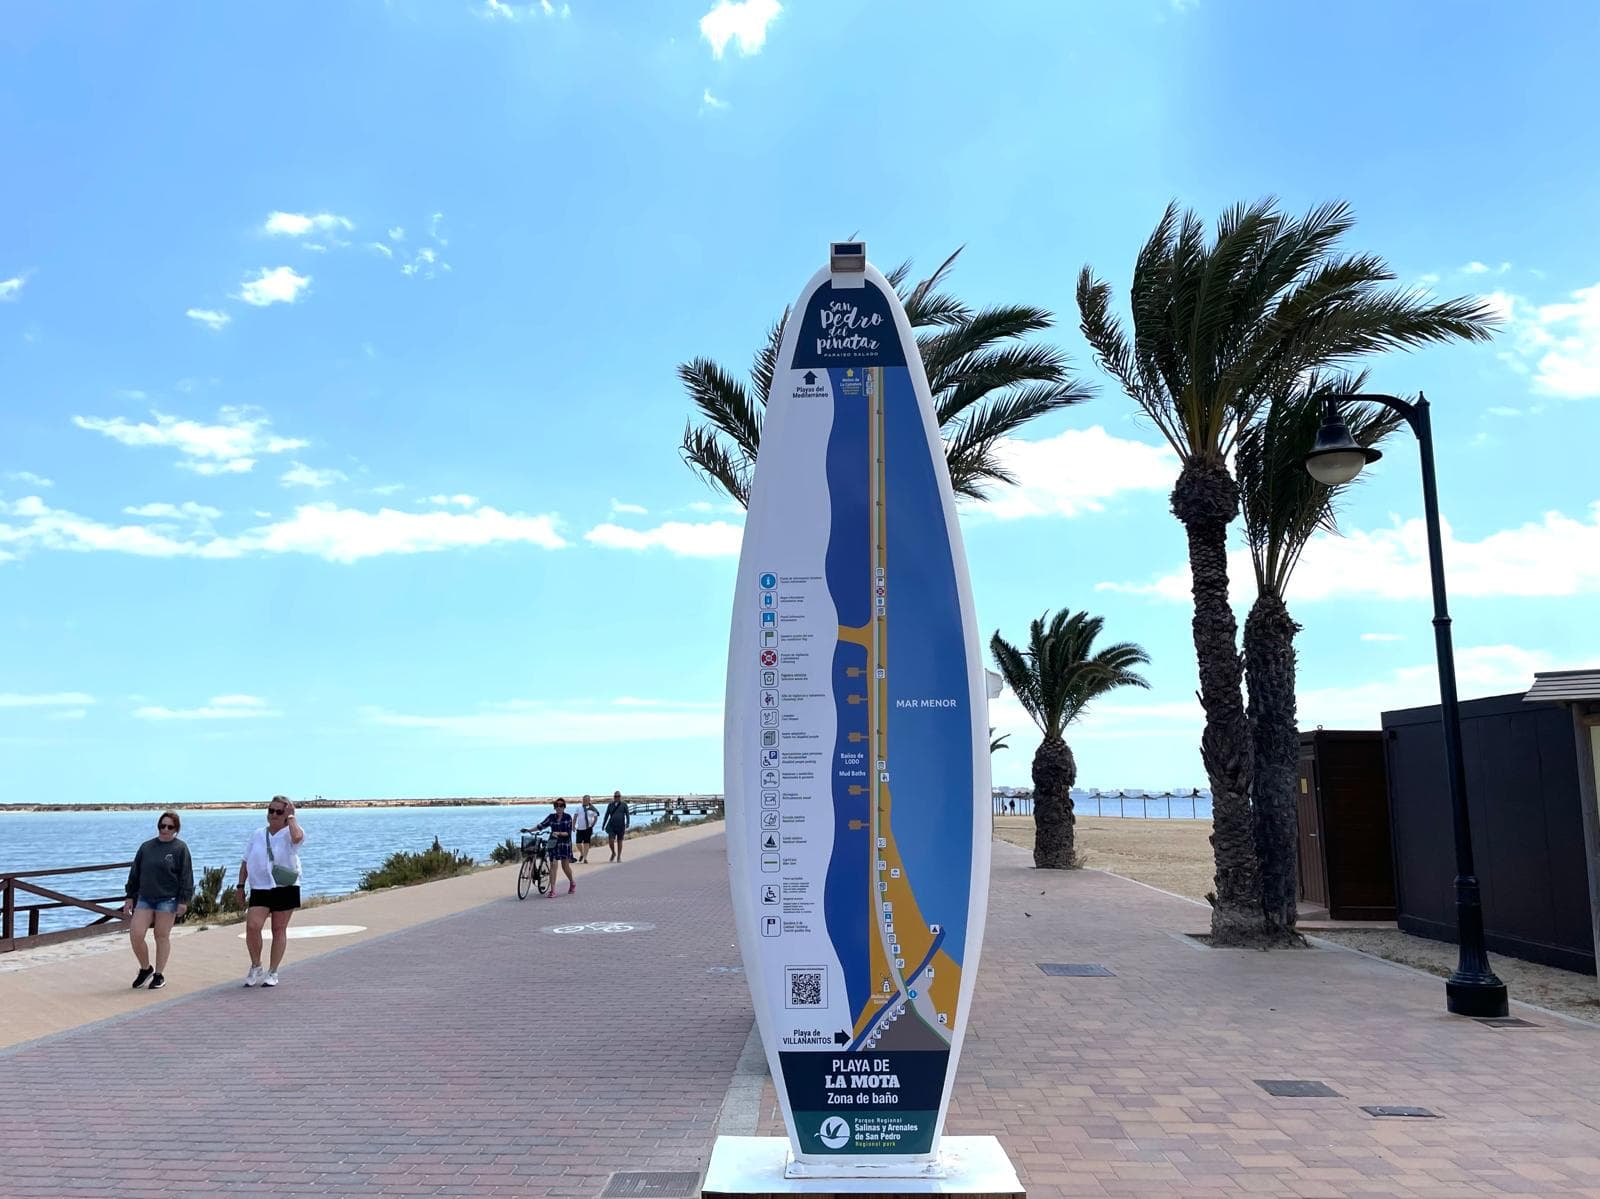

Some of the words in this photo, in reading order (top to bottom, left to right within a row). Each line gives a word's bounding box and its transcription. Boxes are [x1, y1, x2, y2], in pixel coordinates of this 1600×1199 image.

[820, 306, 884, 328] Pedro
[796, 386, 815, 394] Playas
[896, 699, 918, 708] MAR
[920, 699, 957, 708] MENOR
[793, 1029, 811, 1038] Playa
[812, 1029, 821, 1037] de
[832, 1059, 870, 1072] PLAYA
[873, 1059, 890, 1072] DE
[824, 1074, 847, 1089] LA
[850, 1074, 901, 1089] MOTA
[827, 1092, 854, 1104] Zona
[856, 1092, 870, 1104] de
[872, 1091, 899, 1104] baño
[854, 1123, 881, 1131] Salinas
[881, 1124, 887, 1132] y
[887, 1123, 918, 1131] Arenales
[854, 1132, 864, 1140] de
[865, 1132, 879, 1140] San
[880, 1132, 901, 1140] Pedro
[855, 1140, 881, 1148] Regional
